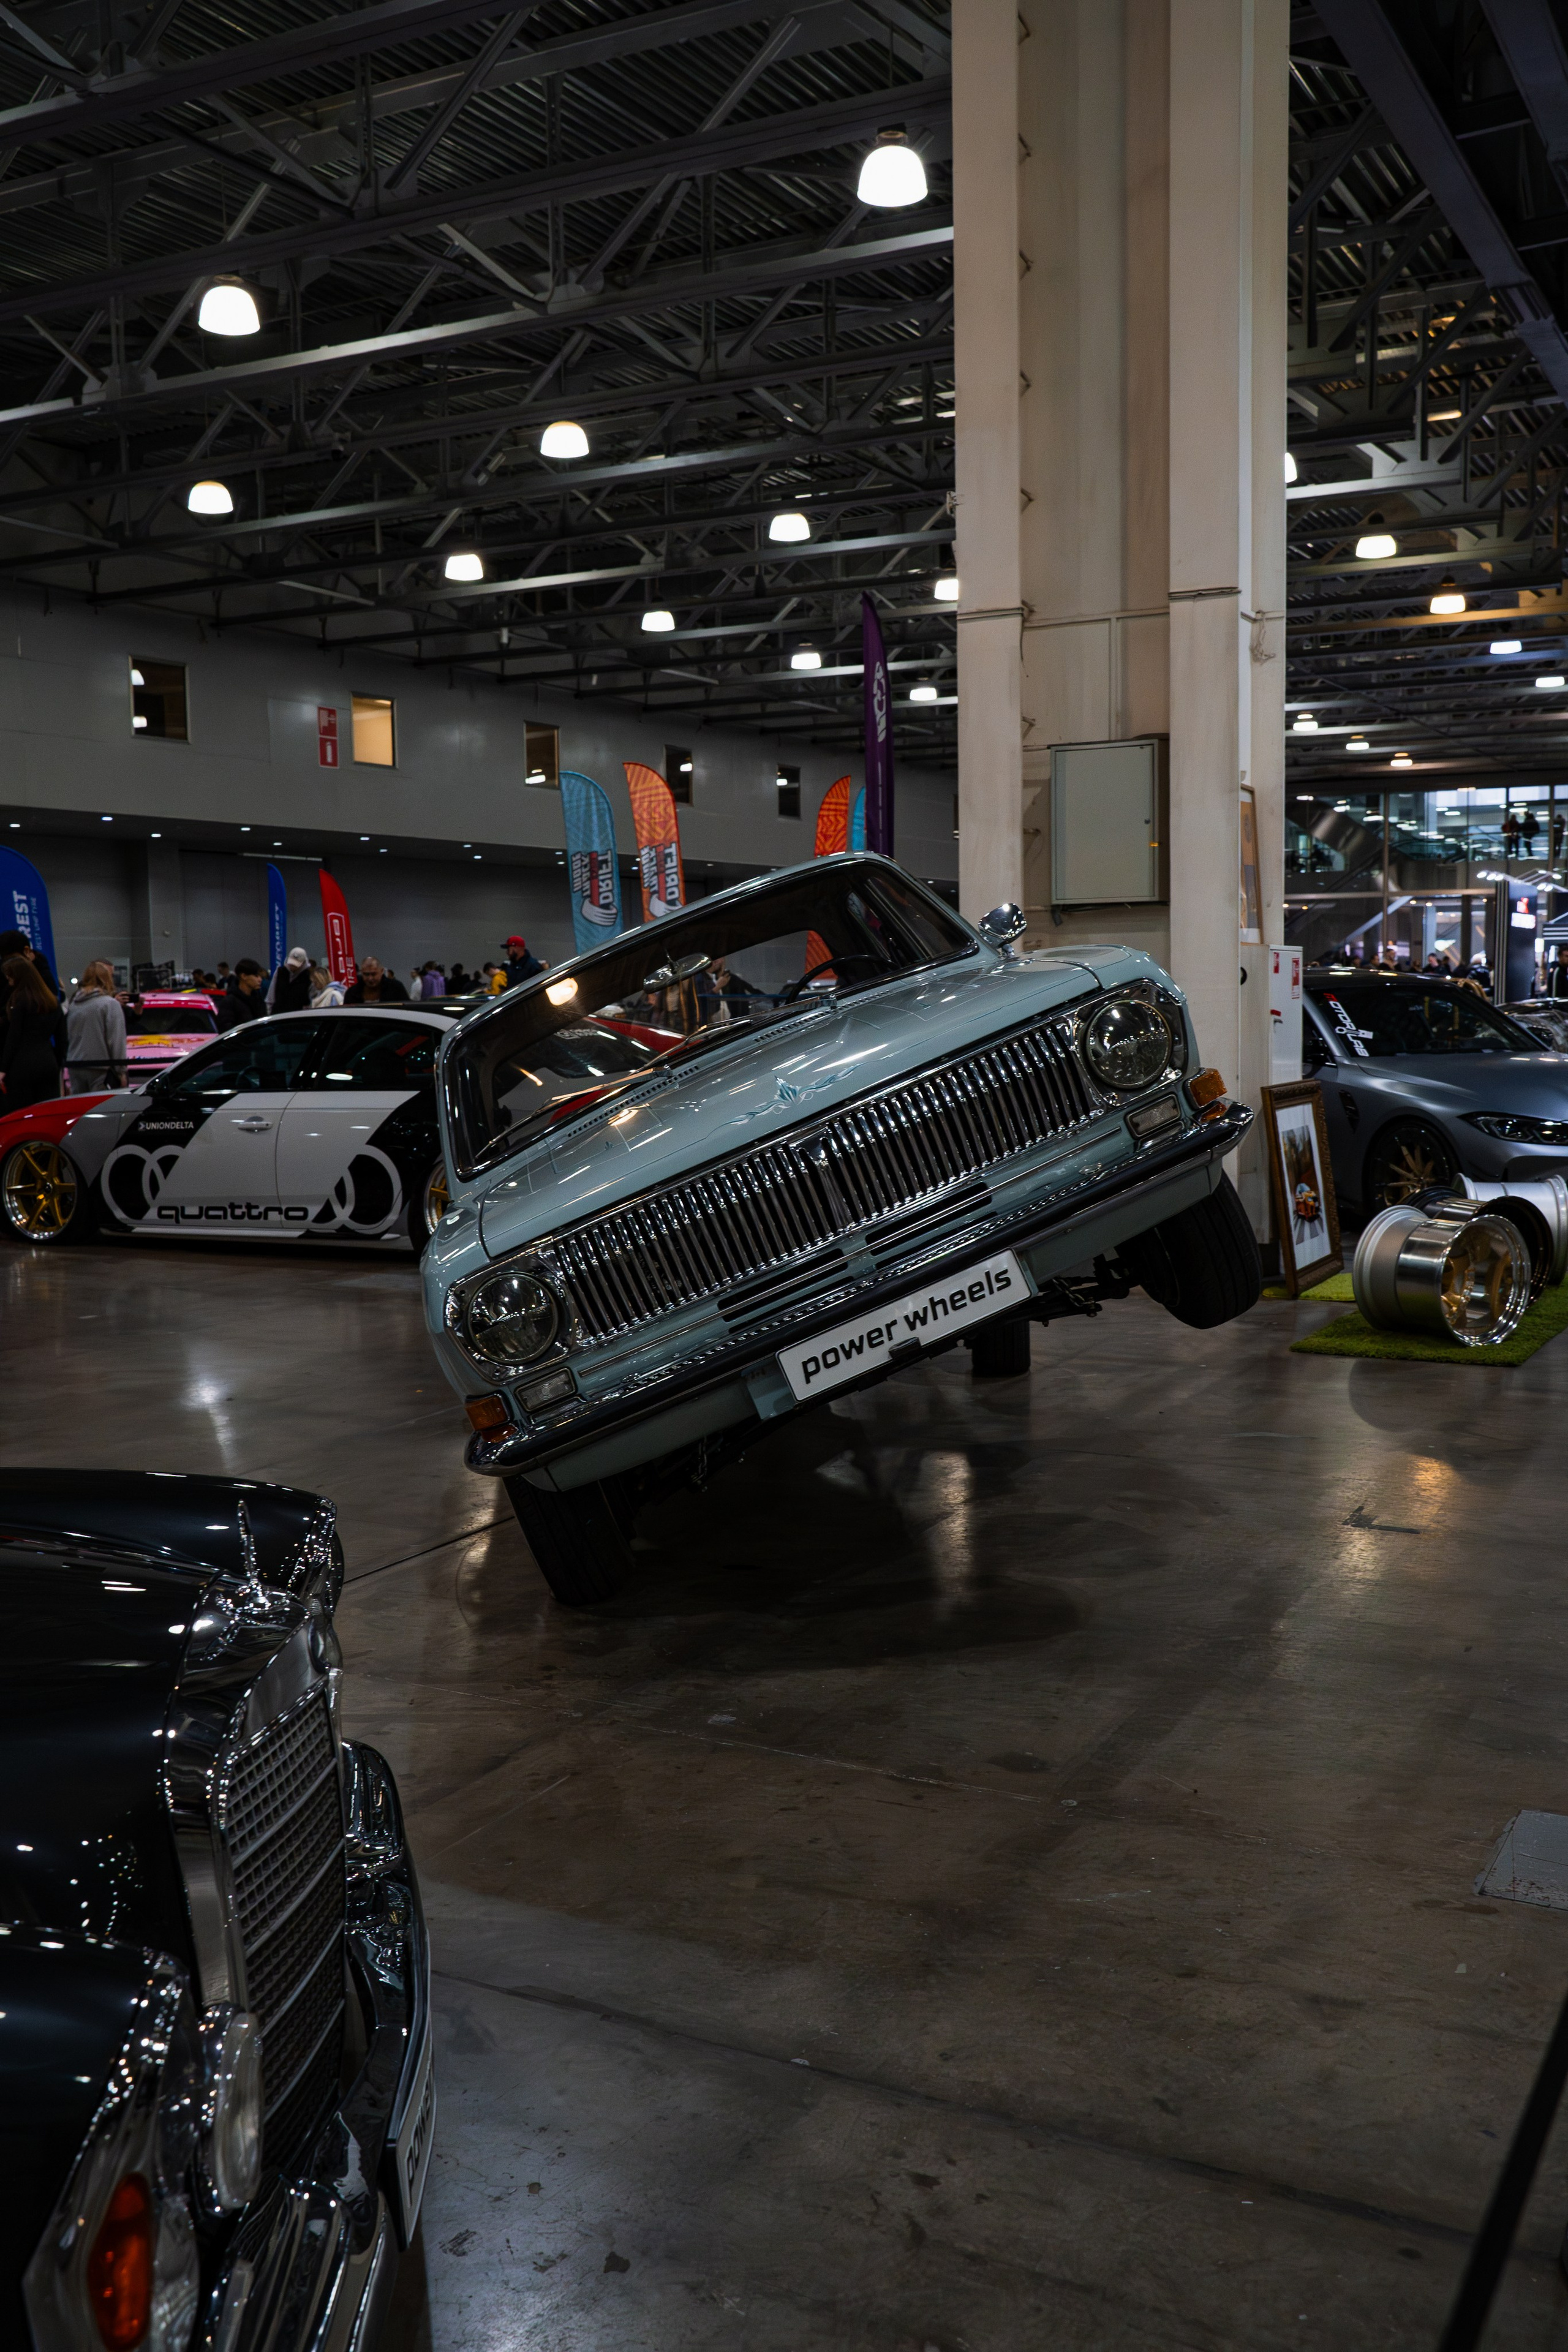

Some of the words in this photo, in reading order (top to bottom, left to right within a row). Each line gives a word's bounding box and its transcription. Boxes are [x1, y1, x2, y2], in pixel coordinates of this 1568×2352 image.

[12, 890, 33, 950] REST
[146, 1121, 195, 1130] UNIONDELTA
[157, 1202, 309, 1224] quattro
[801, 1319, 898, 1384] power
[903, 1268, 1012, 1332] wheels
